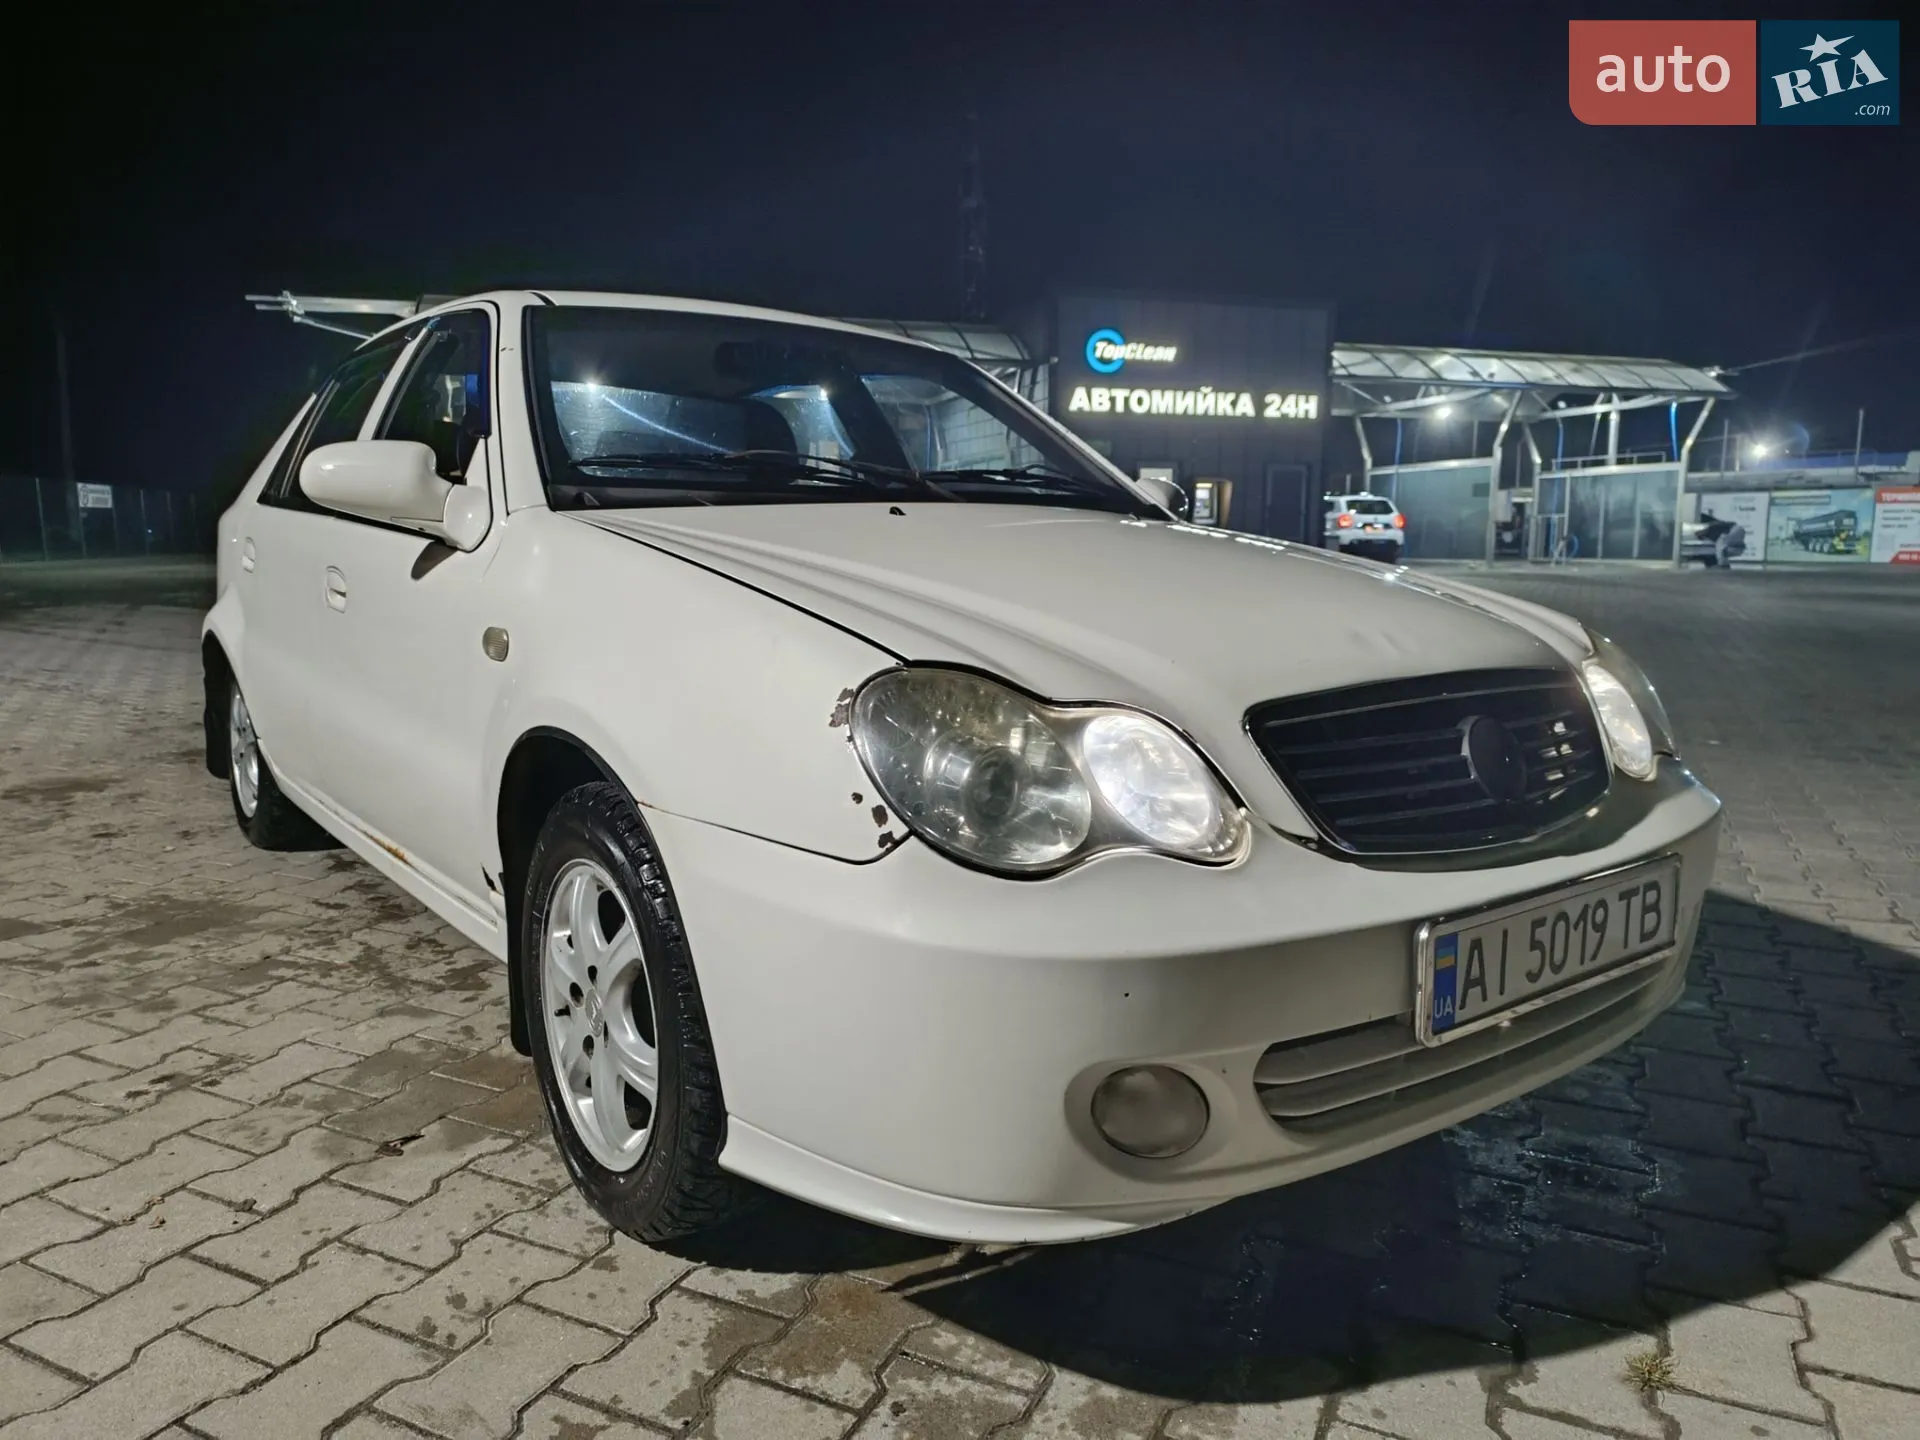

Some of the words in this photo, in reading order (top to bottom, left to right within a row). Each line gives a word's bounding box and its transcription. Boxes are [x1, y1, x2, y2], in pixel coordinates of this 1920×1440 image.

[1068, 385, 1255, 417] АВТОМИЙКА
[1459, 928, 1509, 1011] AI
[1525, 898, 1609, 984] 5019
[1618, 879, 1662, 949] TB
[1433, 994, 1453, 1019] UA
